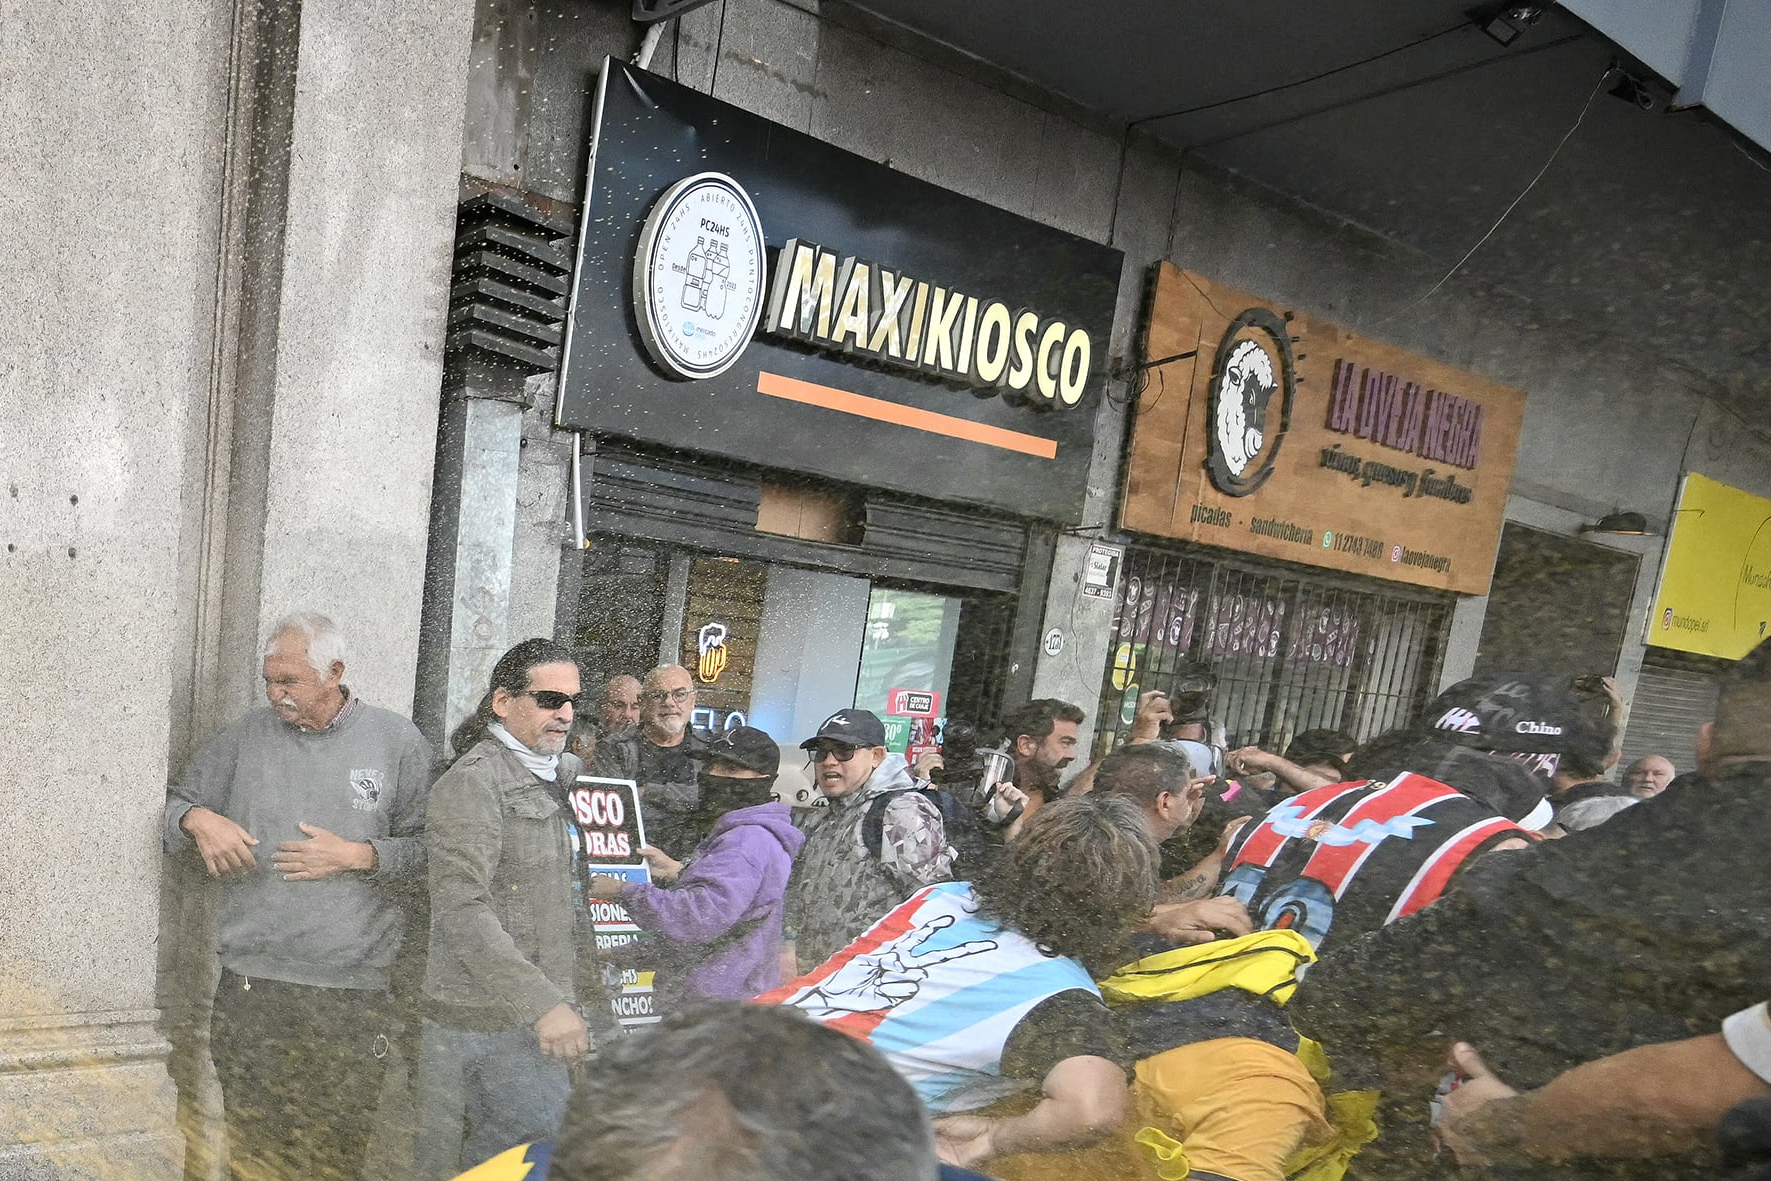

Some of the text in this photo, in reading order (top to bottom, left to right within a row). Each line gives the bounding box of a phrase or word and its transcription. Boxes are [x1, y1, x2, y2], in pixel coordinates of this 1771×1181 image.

[700, 192, 736, 212] ABIERTO
[700, 217, 731, 238] PC24HS
[658, 235, 672, 271] OPEN
[777, 243, 1091, 405] MAXIKIOSCO
[1326, 358, 1485, 470] LA OVEJA NEGRA
[1190, 502, 1232, 528] picadas
[1400, 546, 1452, 573] laovejanegra
[1515, 720, 1563, 736] Chino
